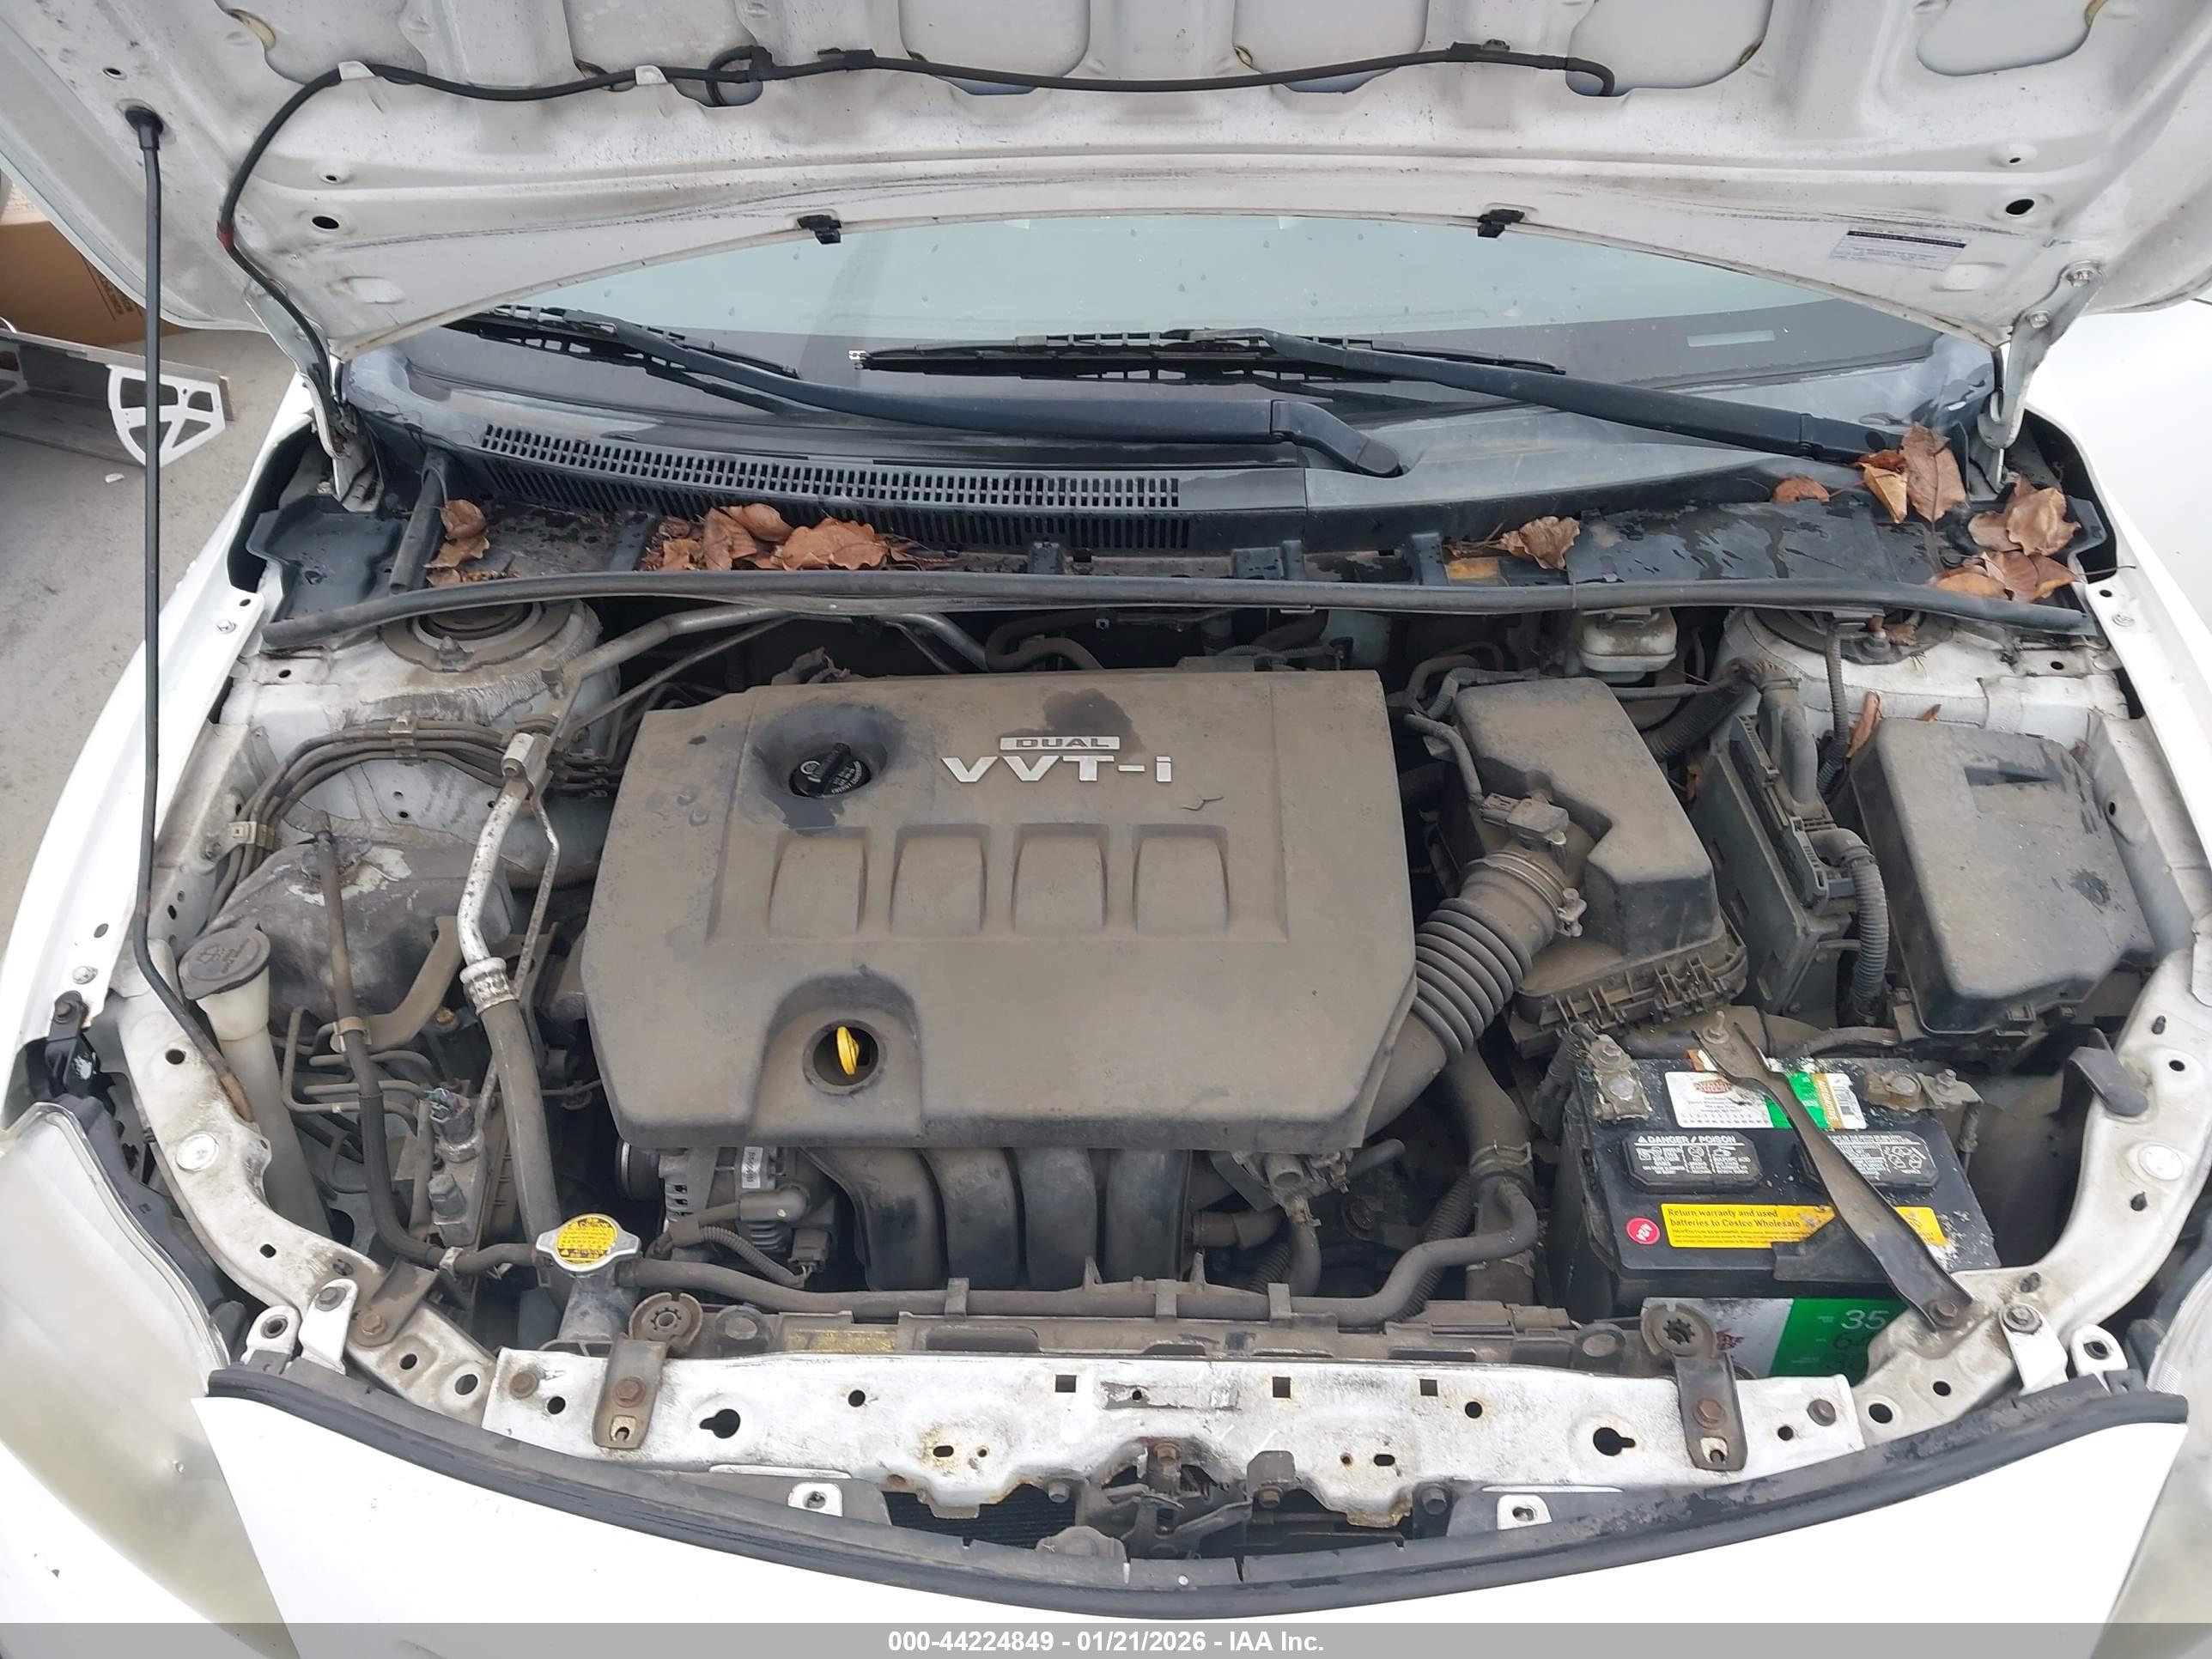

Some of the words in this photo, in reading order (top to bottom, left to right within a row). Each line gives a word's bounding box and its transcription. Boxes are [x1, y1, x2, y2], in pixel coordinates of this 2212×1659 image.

[1016, 738, 1109, 748] DUAL
[941, 754, 1173, 782] VVT-i
[1647, 1135, 1689, 1144] DANGER
[1698, 1135, 1737, 1144] POISON
[1668, 1208, 1697, 1217] Return
[1699, 1209, 1735, 1218] warranty
[1757, 1209, 1778, 1218] used
[1670, 1218, 1709, 1227] batteries
[1723, 1219, 1752, 1228] Costco
[1753, 1219, 1801, 1229] Wholesale
[1840, 1309, 1890, 1330] 35
